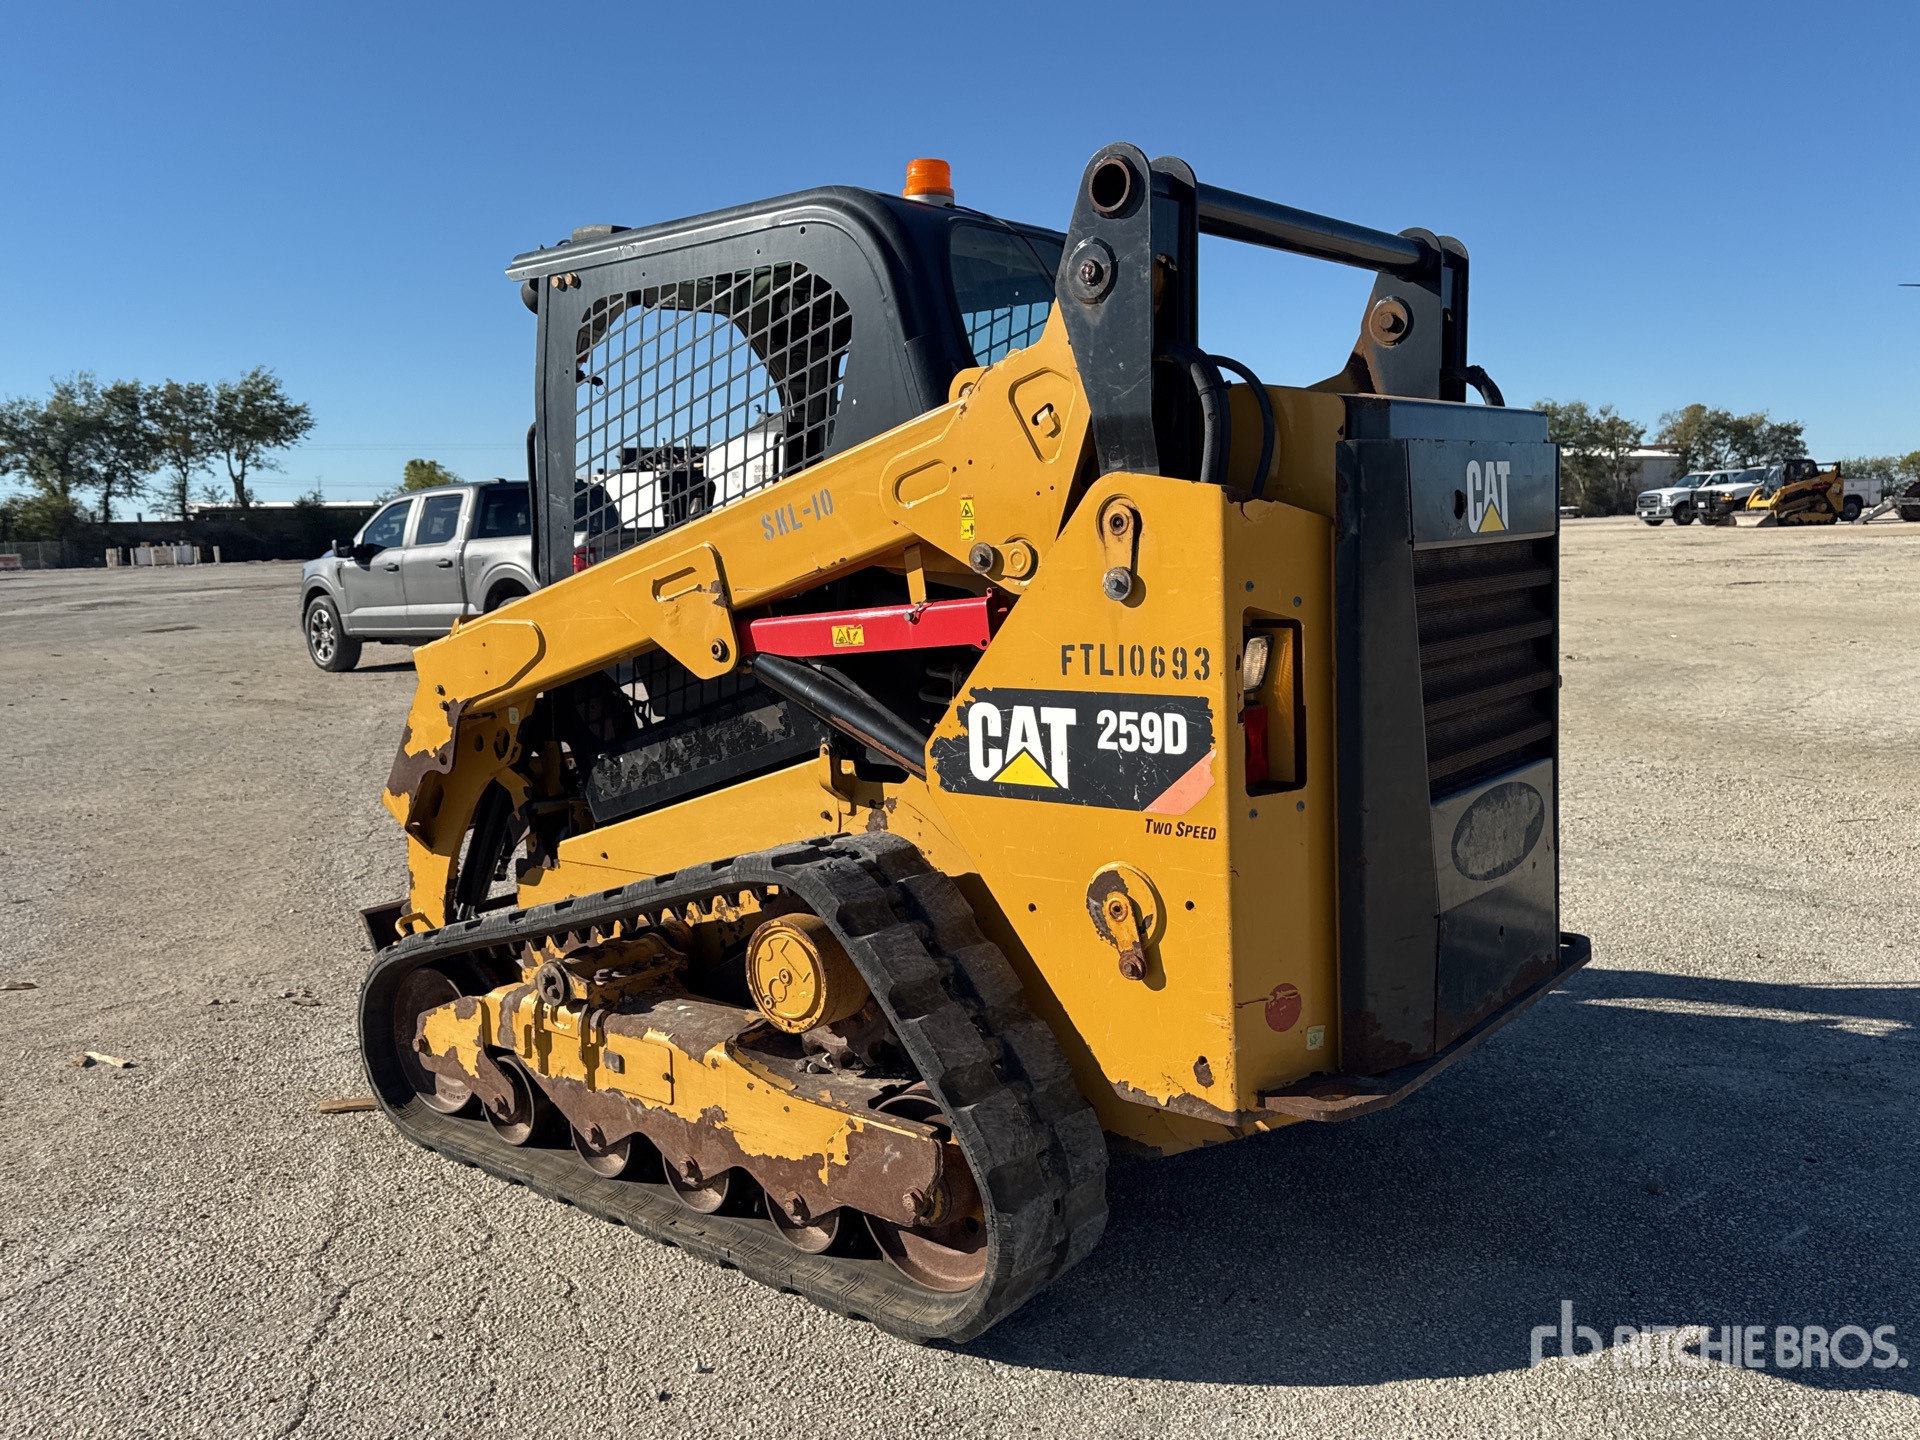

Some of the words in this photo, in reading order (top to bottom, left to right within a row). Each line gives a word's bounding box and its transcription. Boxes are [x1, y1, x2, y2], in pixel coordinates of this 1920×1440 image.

[761, 488, 833, 541] SKL-10
[1466, 460, 1511, 534] CAT
[1061, 643, 1210, 681] FTL10693
[968, 702, 1076, 789] CAT
[1097, 709, 1188, 755] 259D
